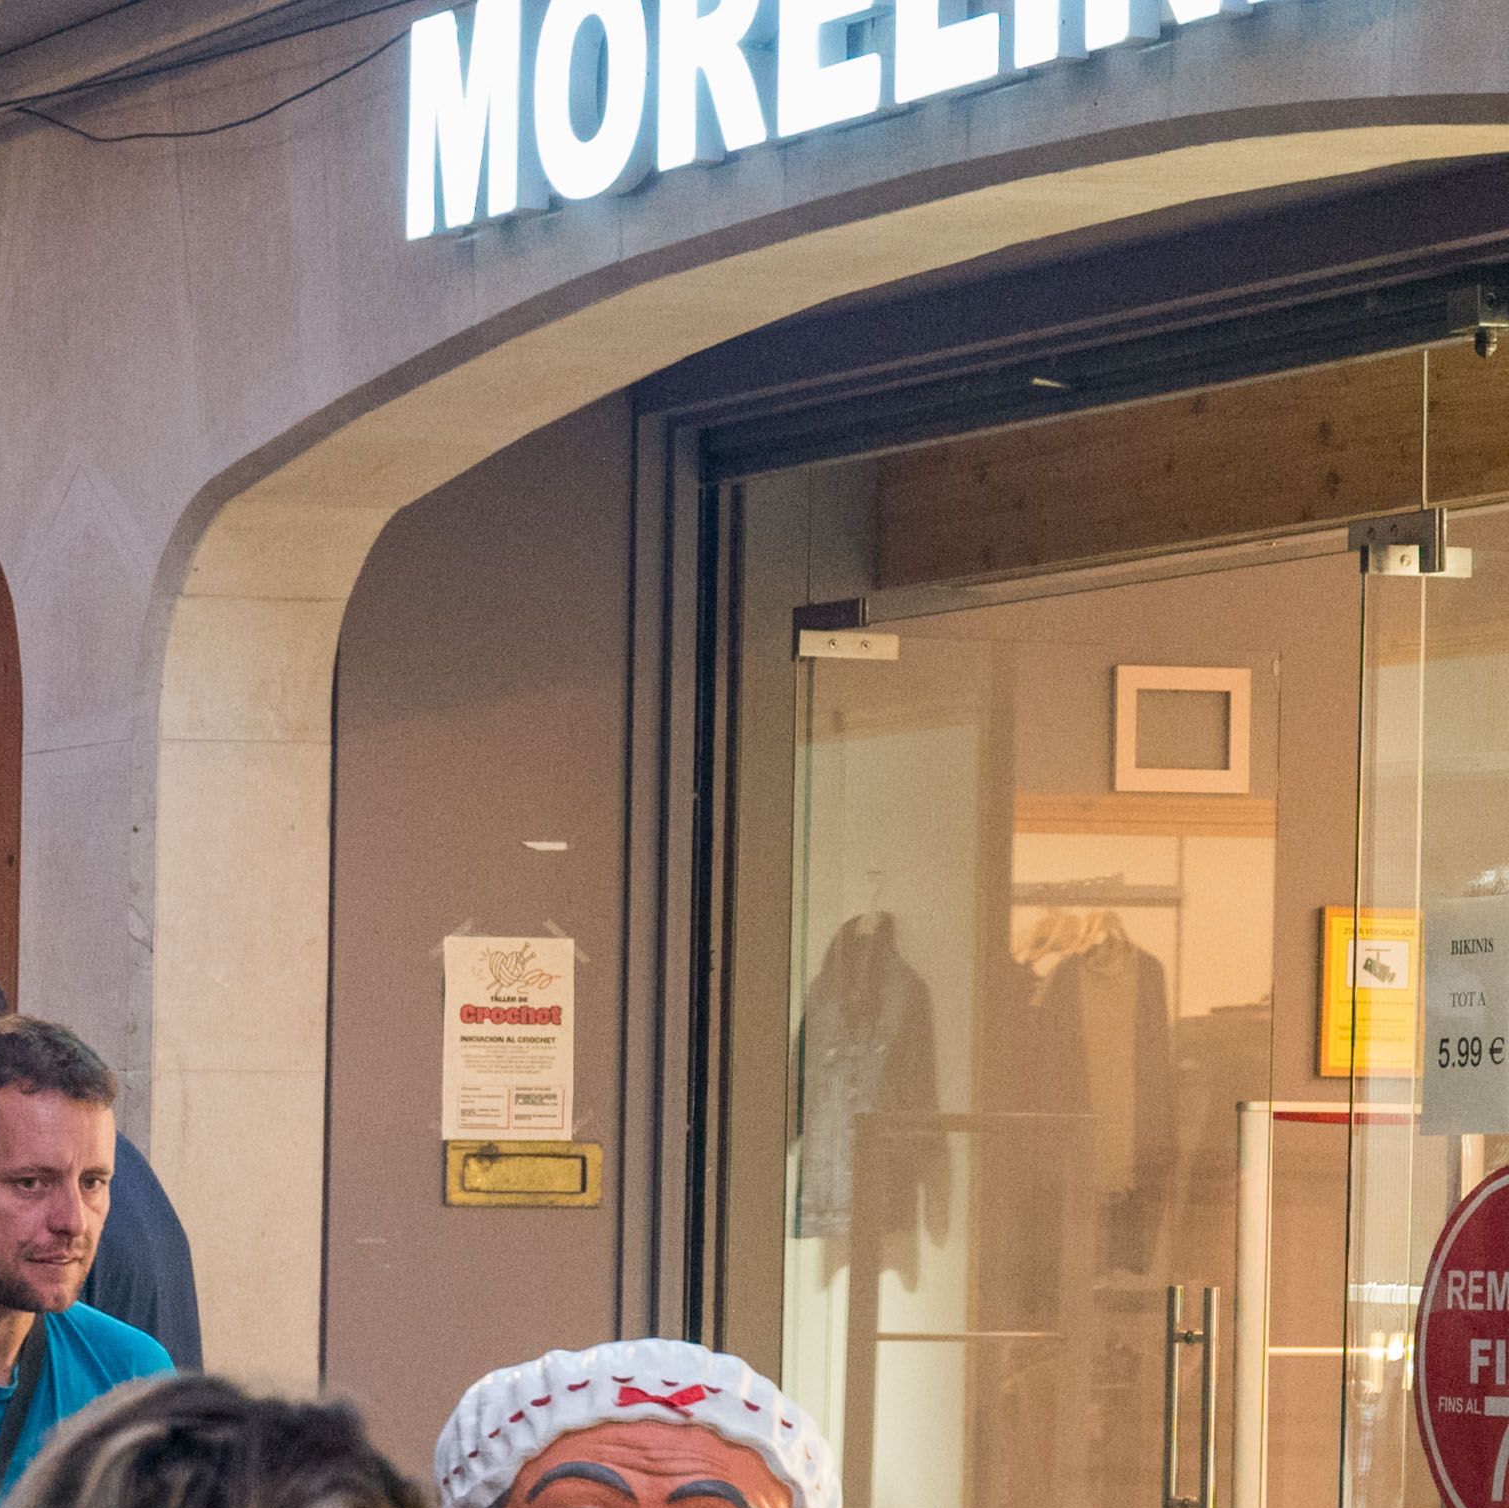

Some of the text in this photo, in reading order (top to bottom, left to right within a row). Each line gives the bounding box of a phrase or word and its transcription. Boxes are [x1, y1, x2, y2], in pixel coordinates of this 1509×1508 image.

[1450, 938, 1494, 956] BIKINIS
[490, 995, 517, 1003] TALLER
[1449, 992, 1486, 1008] TOT A
[460, 1004, 561, 1025] Crochet
[517, 1036, 556, 1044] CROCHET
[1438, 1036, 1505, 1069] 5.99 €
[1447, 1269, 1509, 1312] REM
[1469, 1338, 1509, 1386] FI
[1438, 1395, 1482, 1415] FINS AL
